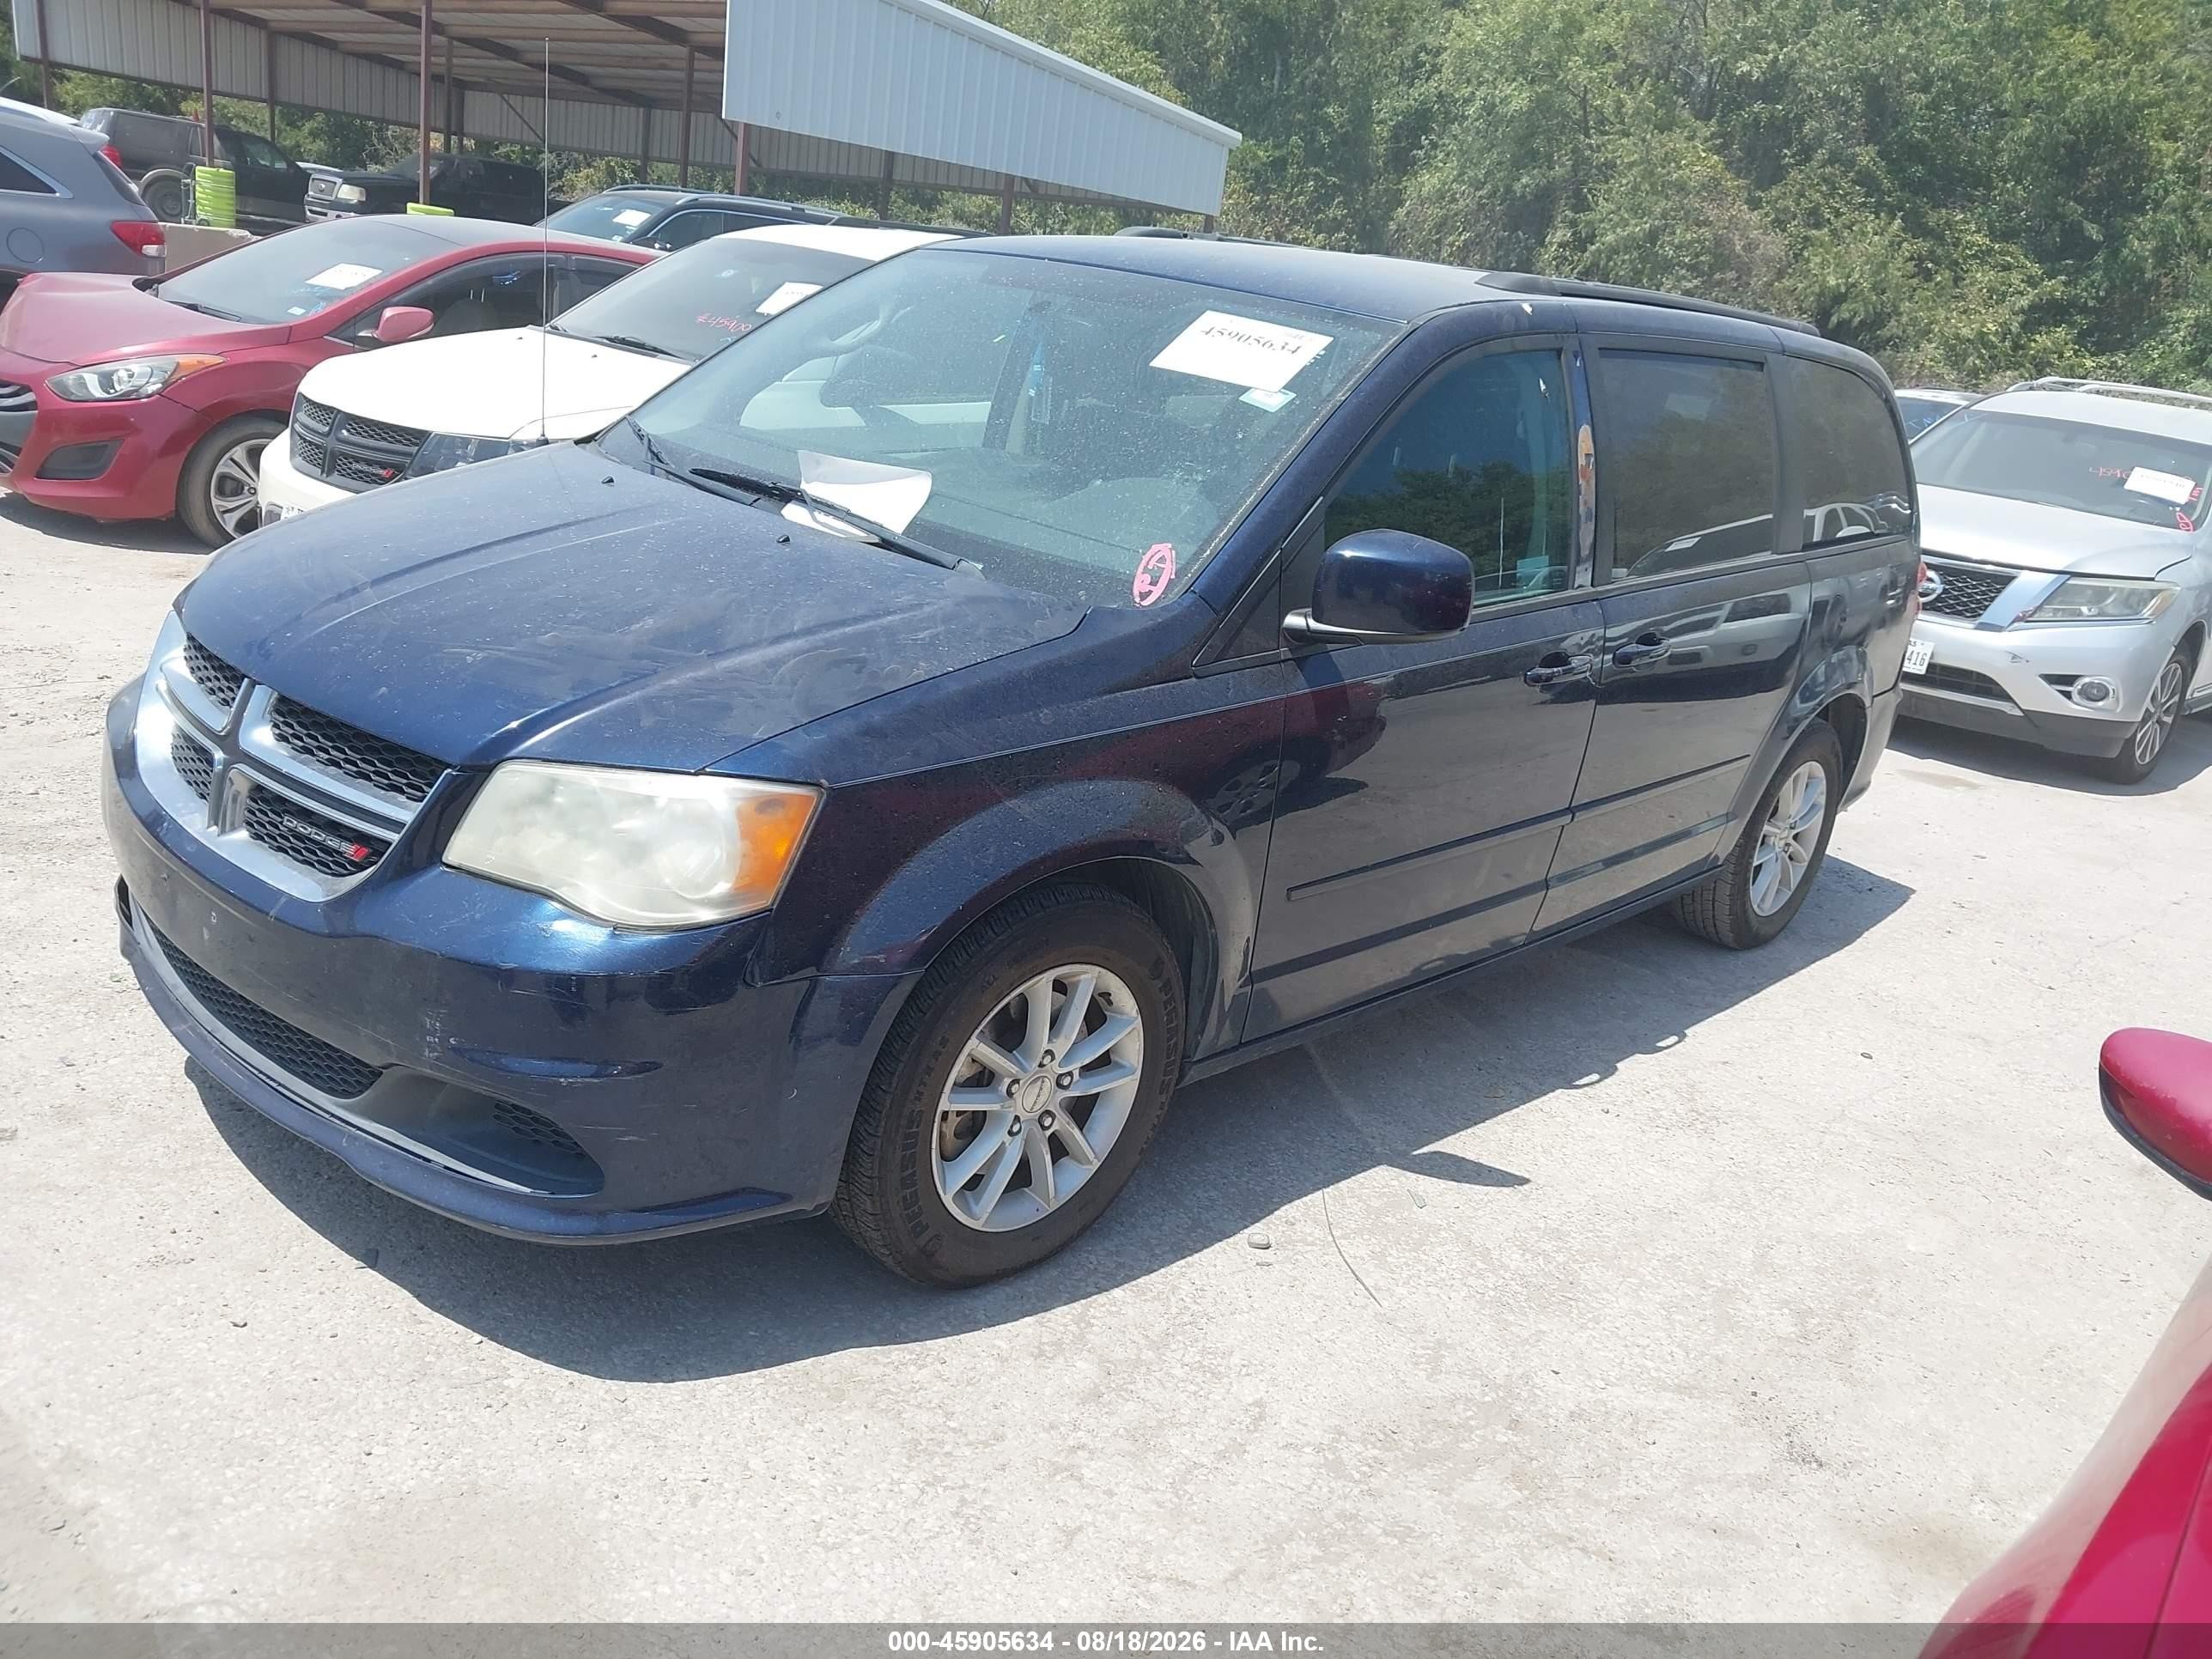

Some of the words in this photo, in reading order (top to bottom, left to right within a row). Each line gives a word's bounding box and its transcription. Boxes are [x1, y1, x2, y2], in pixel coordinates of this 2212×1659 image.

[1200, 325, 1303, 355] 45905634
[1906, 650, 1927, 666] 416
[283, 816, 356, 858] DODGE
[901, 1109, 931, 1237] PEGASUS
